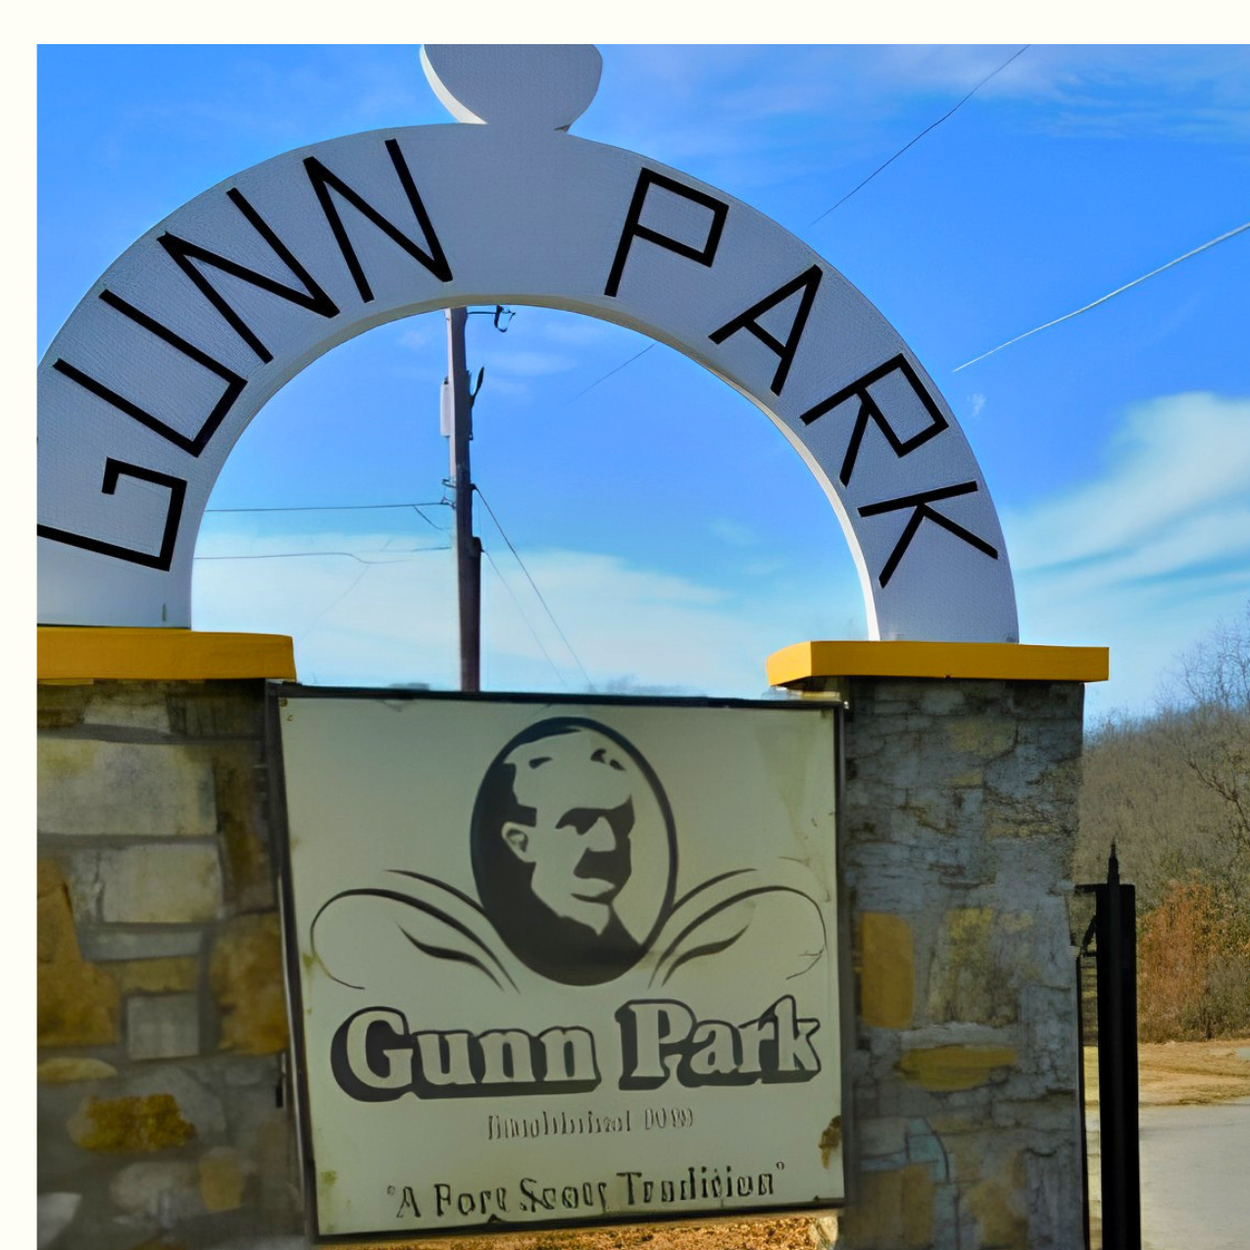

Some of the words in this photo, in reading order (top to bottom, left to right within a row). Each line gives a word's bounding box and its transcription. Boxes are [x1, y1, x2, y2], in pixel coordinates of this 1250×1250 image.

[37, 139, 454, 571] GUNN
[604, 167, 998, 588] PARK
[331, 1006, 601, 1102] Gunn
[614, 995, 821, 1091] Park
